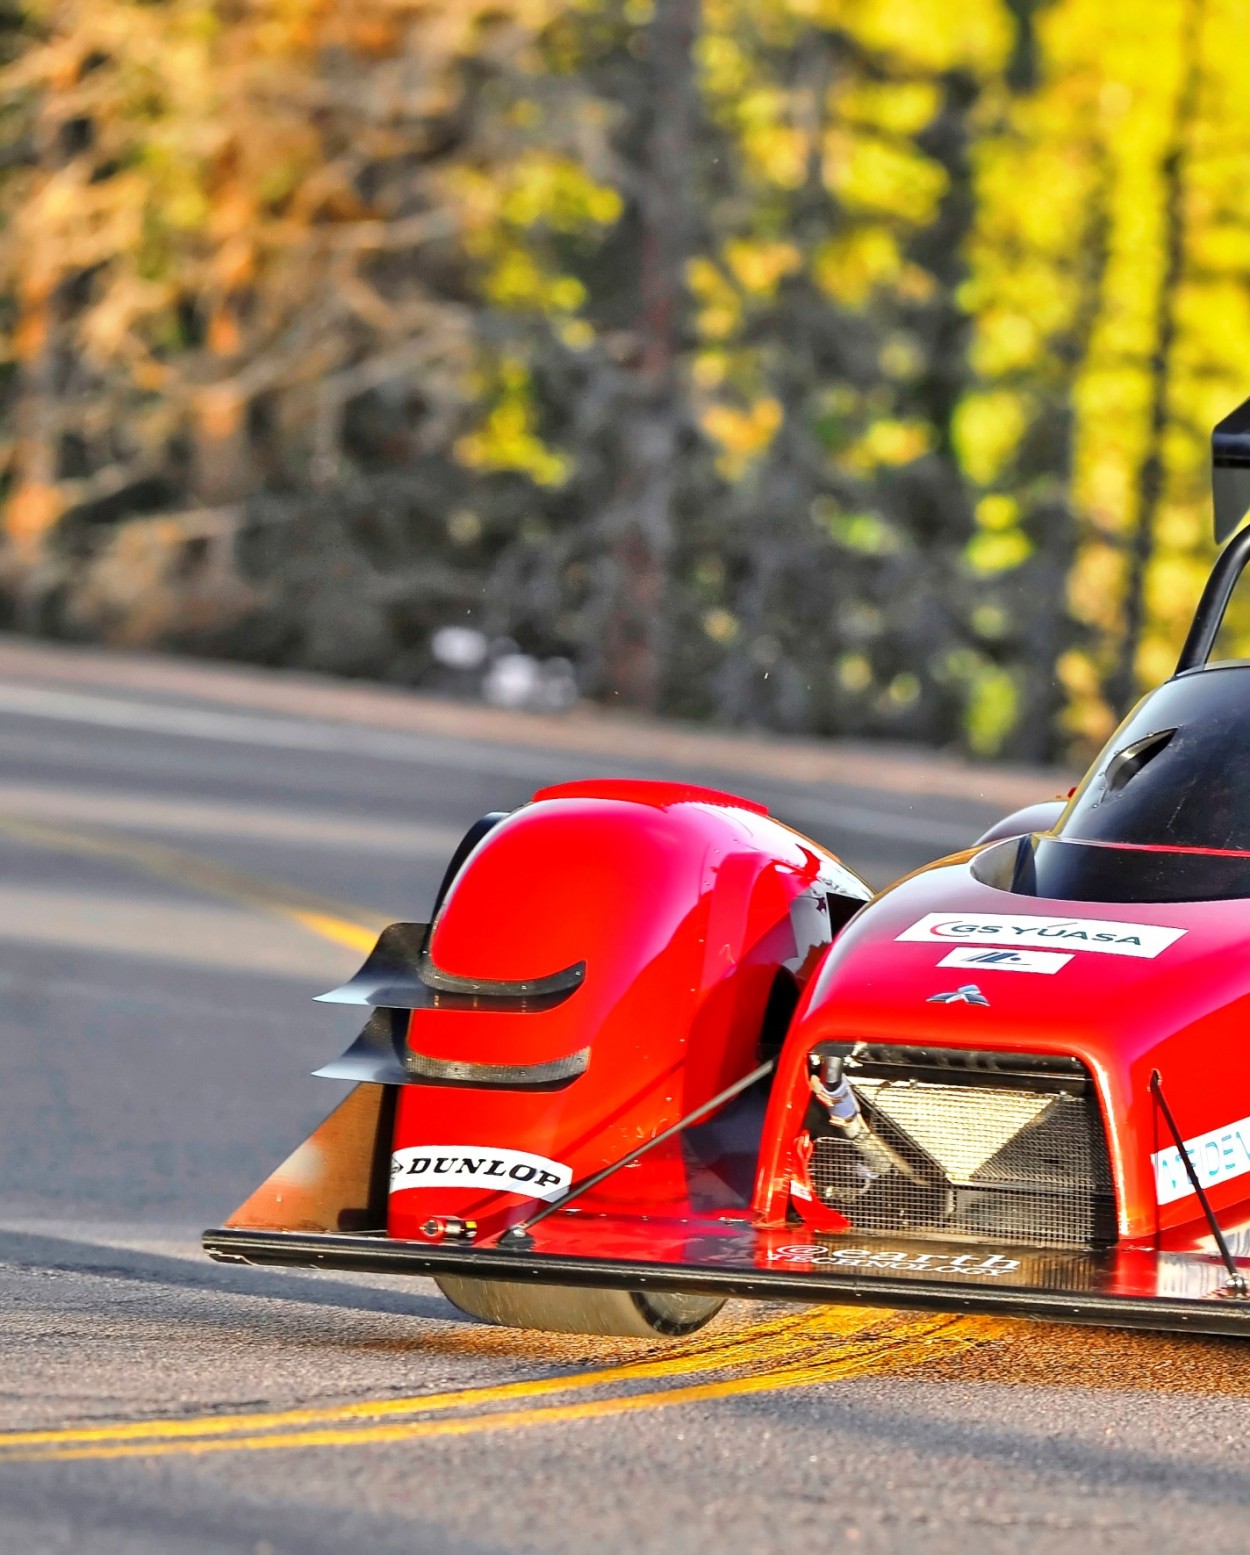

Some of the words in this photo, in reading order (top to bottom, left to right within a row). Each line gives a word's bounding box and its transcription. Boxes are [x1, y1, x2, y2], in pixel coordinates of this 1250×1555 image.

[951, 924, 1004, 935] GS
[1010, 926, 1142, 946] YUASA
[406, 1157, 561, 1187] DUNLOP
[766, 1253, 1015, 1277] TECHNOLOGY
[776, 1244, 1021, 1270] @earth
